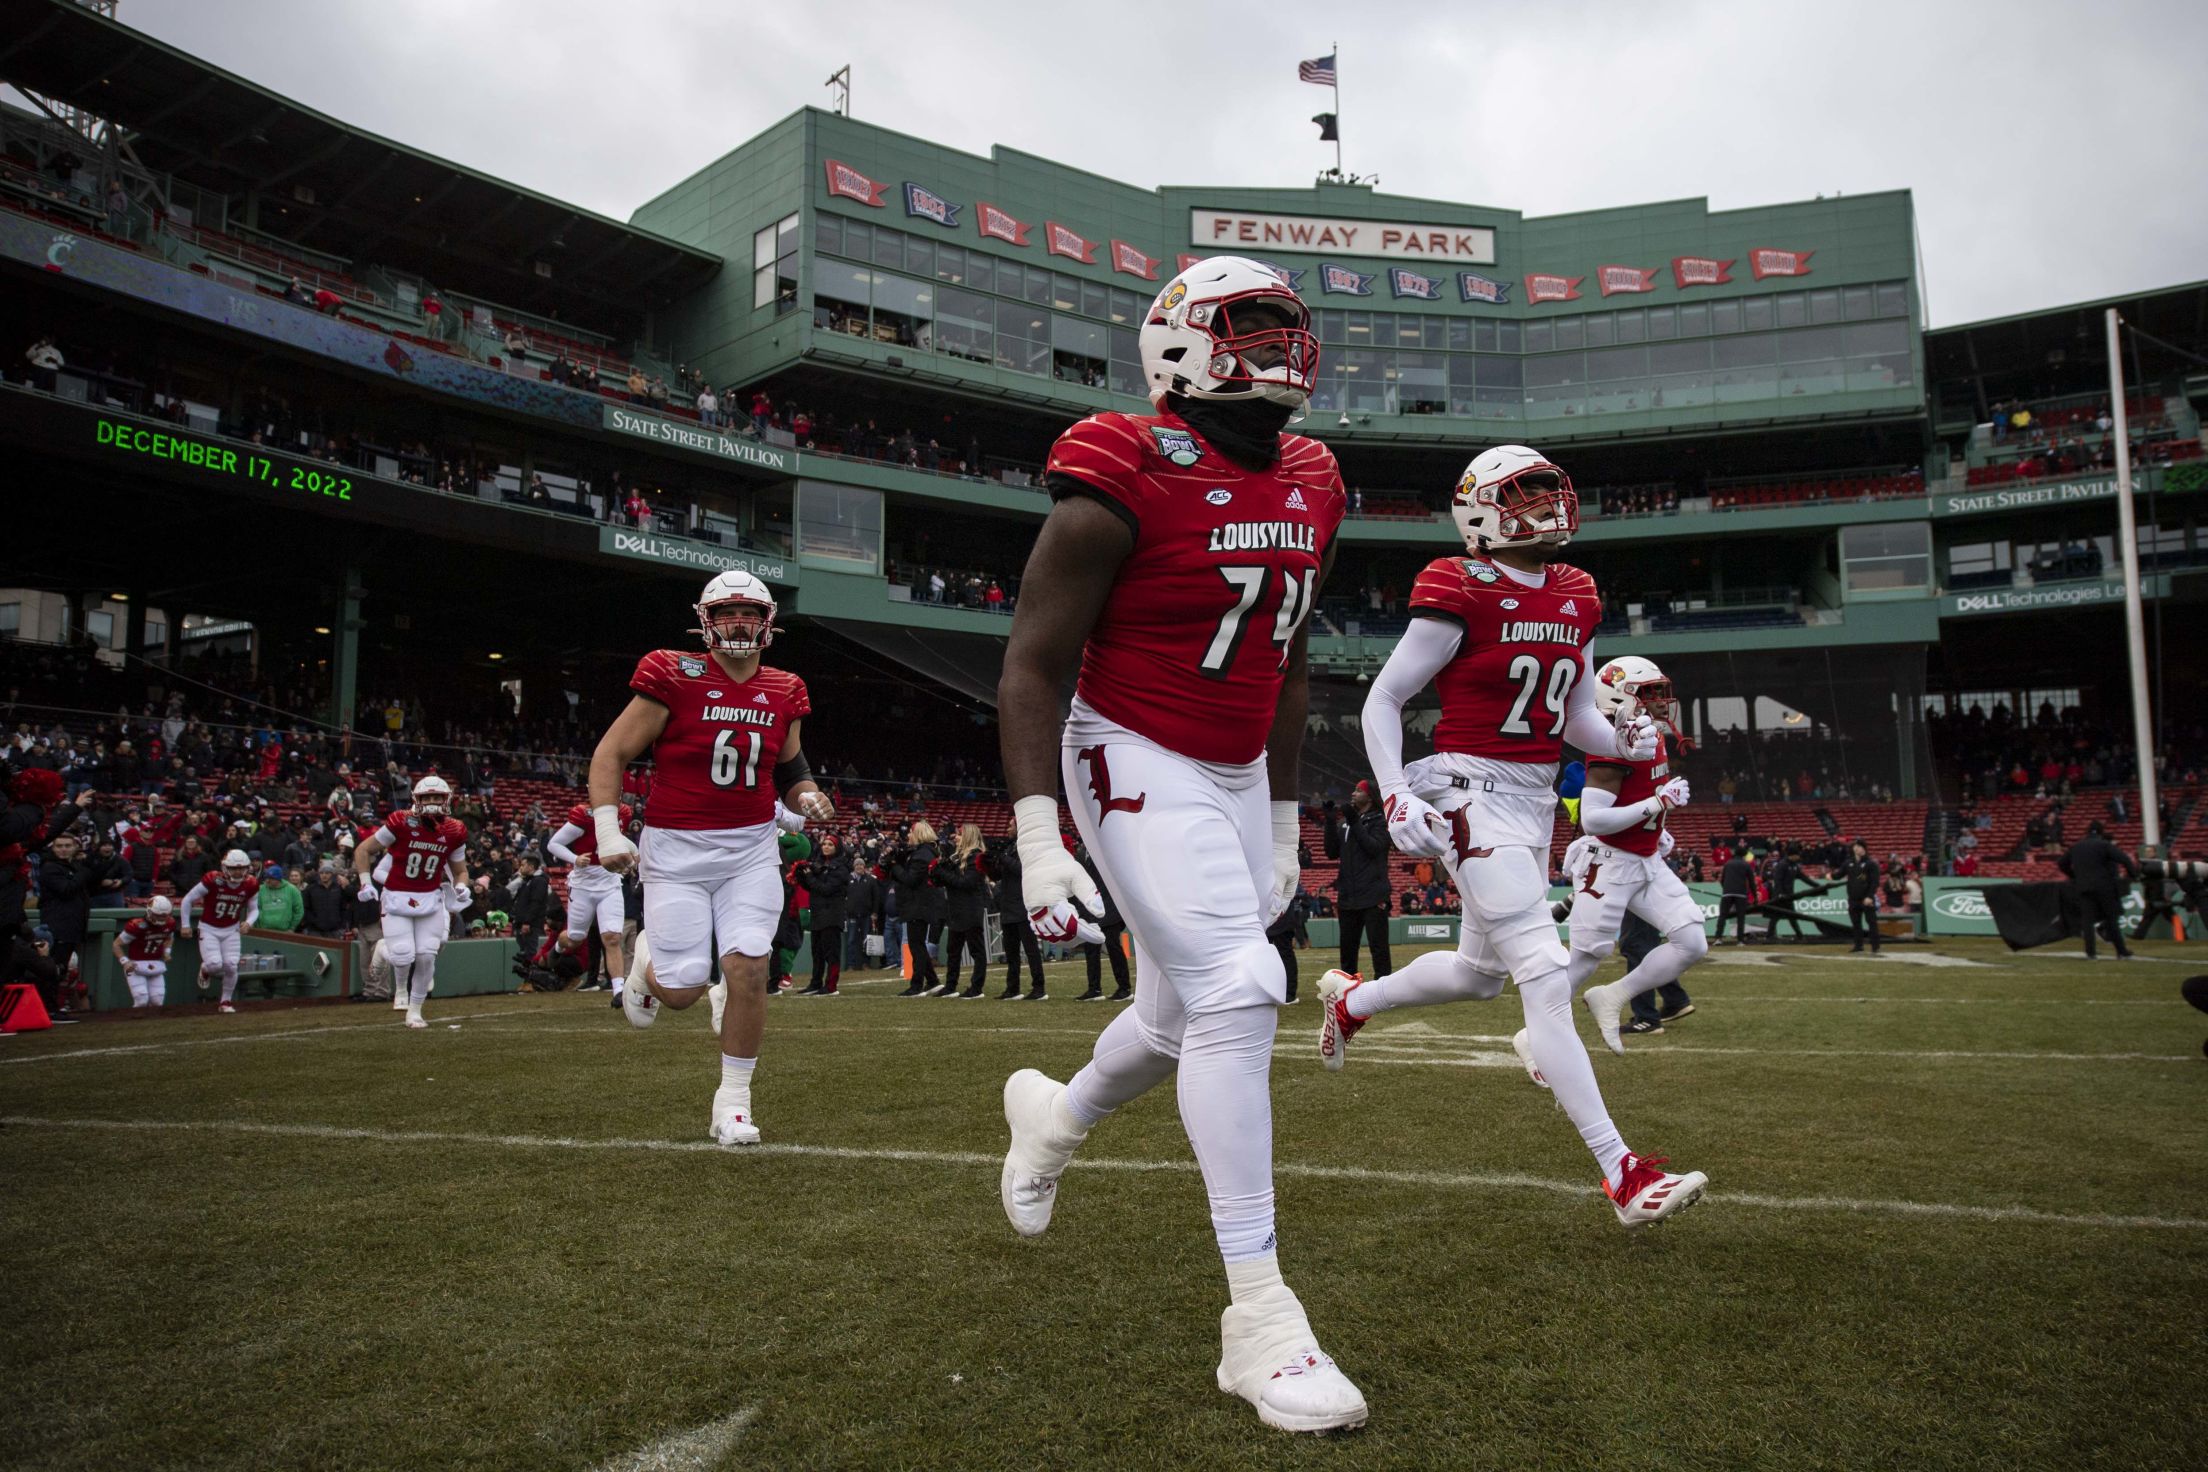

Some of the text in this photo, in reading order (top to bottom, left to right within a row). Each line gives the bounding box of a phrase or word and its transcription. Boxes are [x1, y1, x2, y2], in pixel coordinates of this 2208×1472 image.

[1213, 218, 1474, 255] FENWAY PARK
[612, 410, 784, 468] STATE STREET PAVILION
[1160, 437, 1202, 456] BOWL
[96, 418, 352, 501] DECEMBER 17, 2022
[1209, 491, 1229, 500] ACC
[1285, 501, 1308, 512] adidas
[1949, 495, 1995, 513] STATE
[1997, 487, 2055, 508] STREET
[1208, 522, 1315, 551] LOUISVILLE
[614, 533, 784, 579] DELL Technologies Level
[1957, 594, 2003, 611] DELL
[2003, 583, 2101, 607] Technologies
[1201, 566, 1316, 670] 74
[1559, 607, 1578, 617] adidas
[1500, 621, 1581, 647] LOUISVILLE
[1500, 655, 1577, 735] 29
[701, 705, 776, 727] LOUISVILLE
[710, 729, 762, 787] 61
[408, 839, 449, 854] LOUISVILLE
[405, 852, 439, 880] 89
[215, 901, 240, 919] 94
